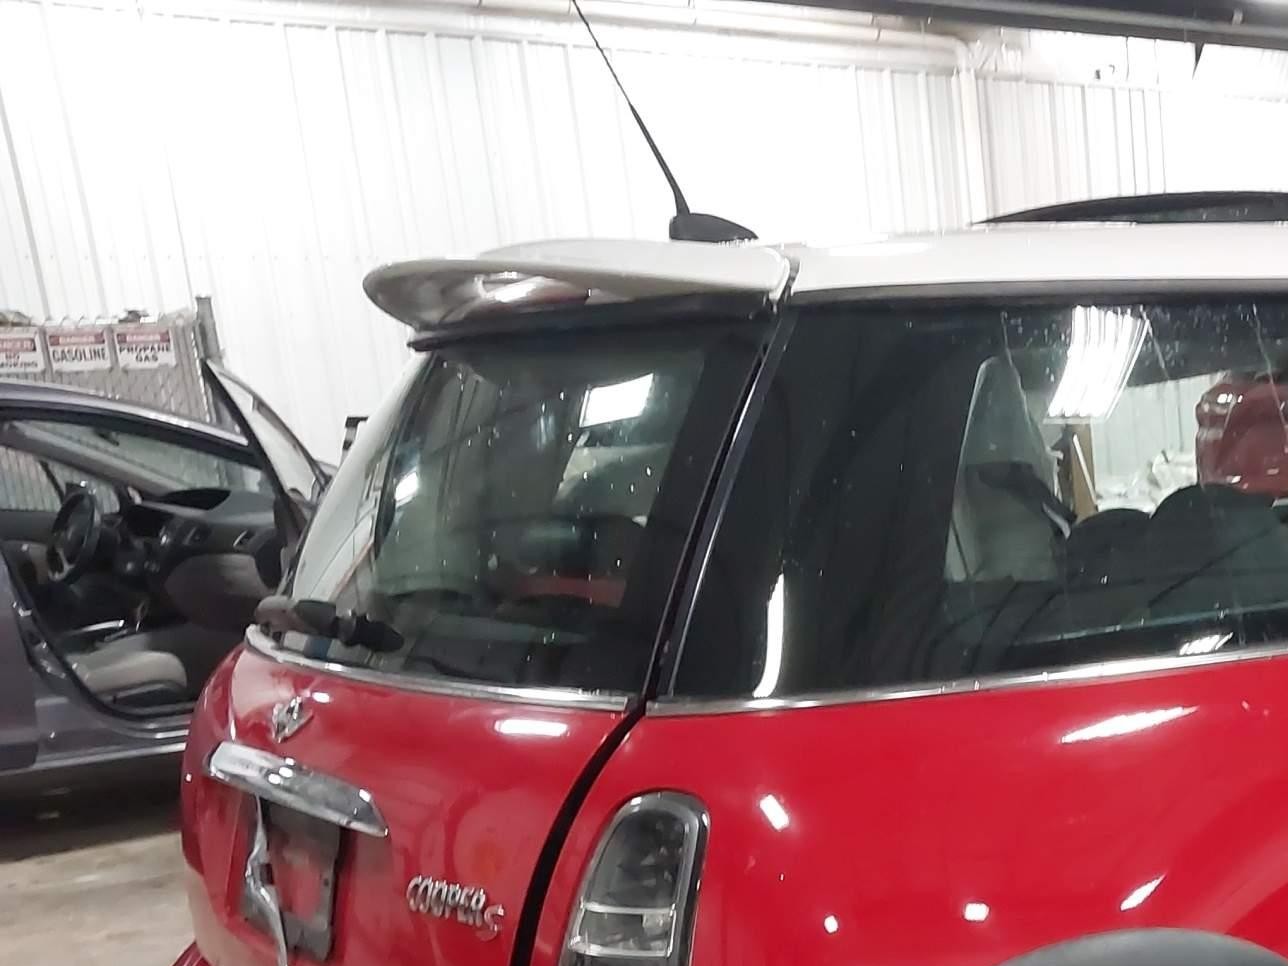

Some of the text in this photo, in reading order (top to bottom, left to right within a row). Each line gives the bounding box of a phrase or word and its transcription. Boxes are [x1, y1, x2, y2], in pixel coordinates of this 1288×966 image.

[52, 347, 105, 362] GASOLINE
[135, 353, 159, 362] GAS
[406, 875, 505, 941] COOPER S
